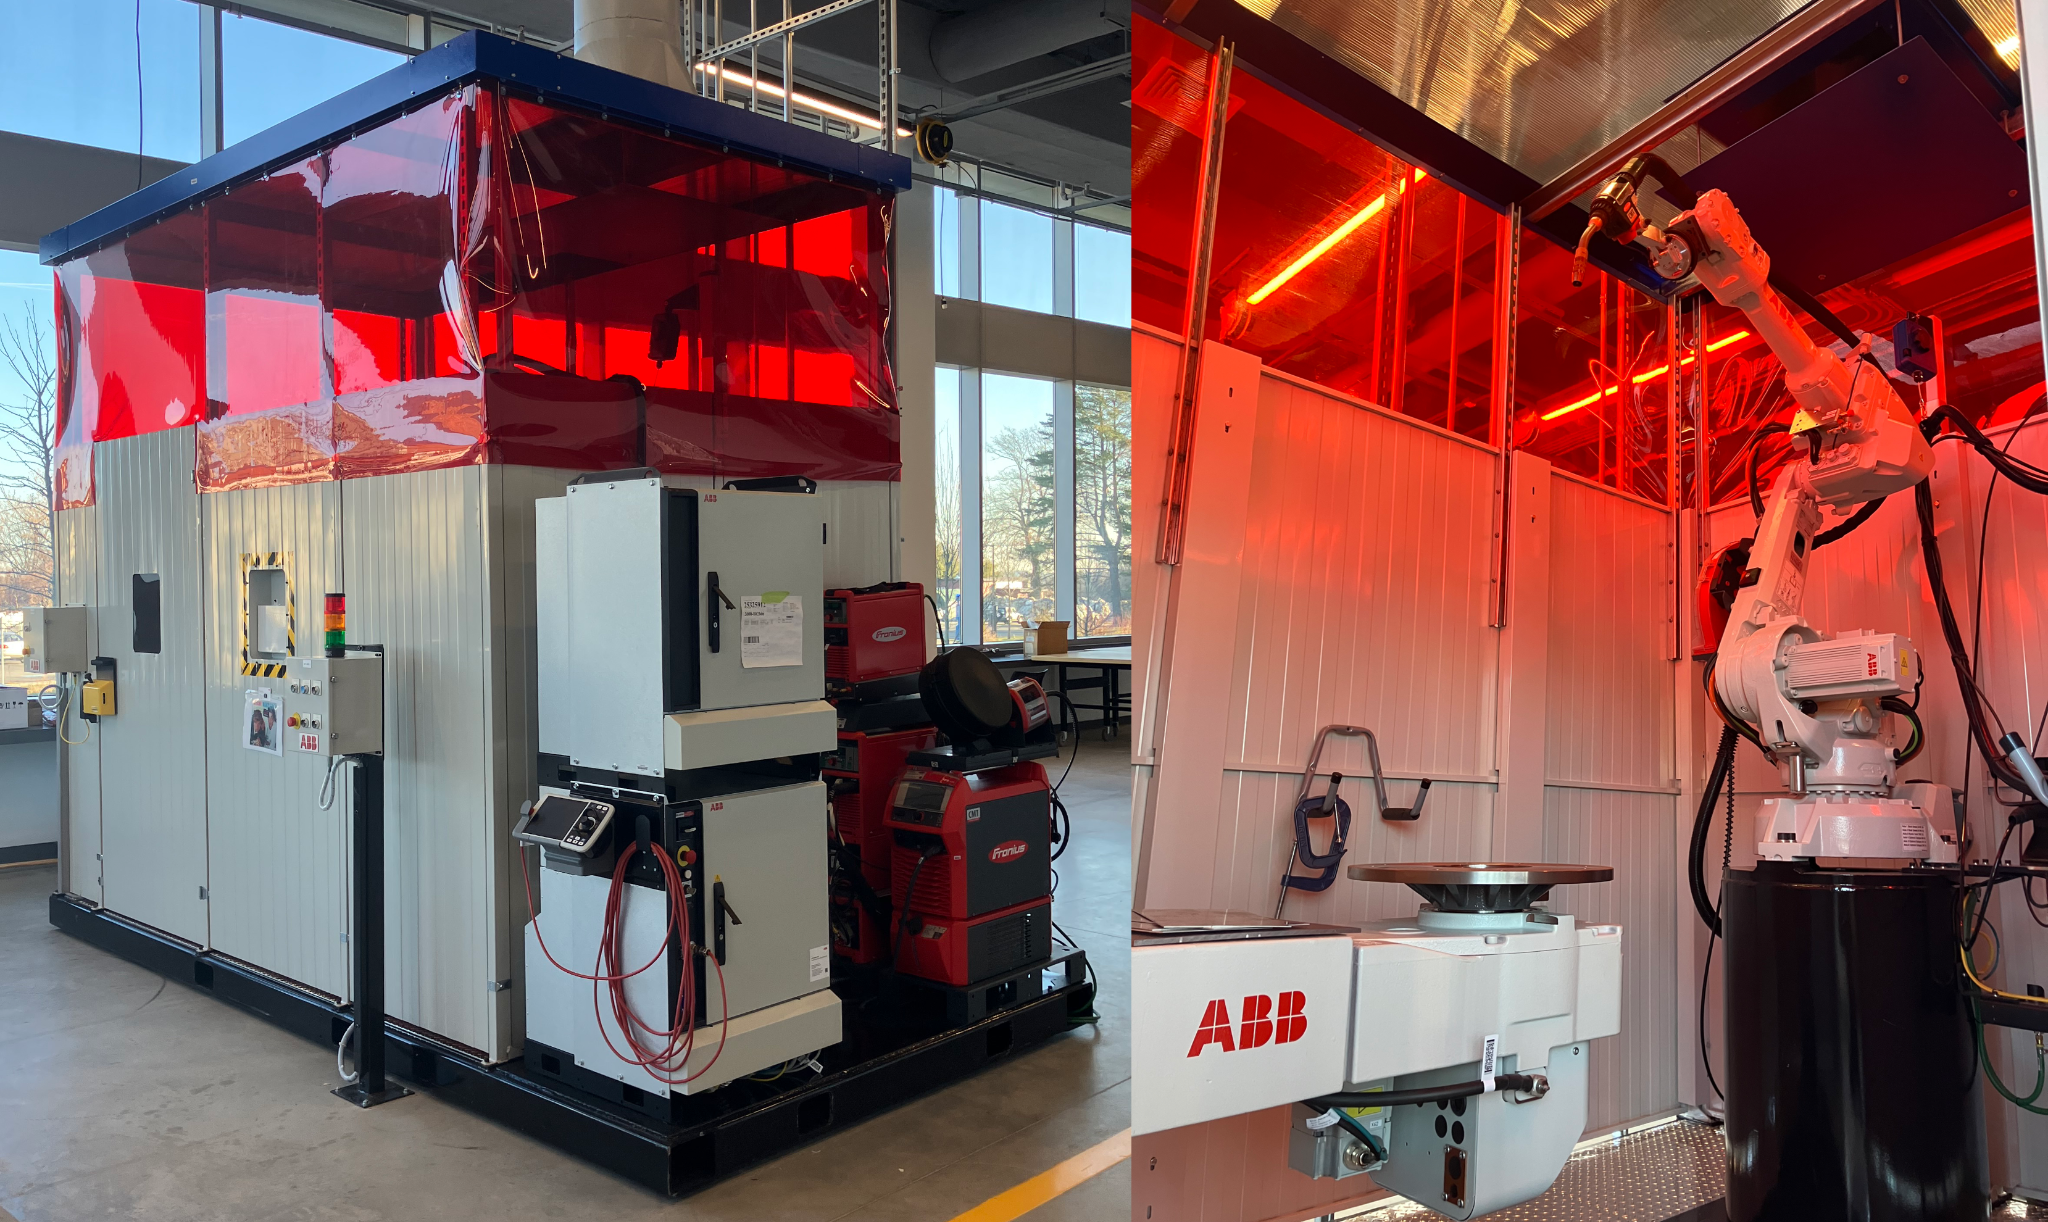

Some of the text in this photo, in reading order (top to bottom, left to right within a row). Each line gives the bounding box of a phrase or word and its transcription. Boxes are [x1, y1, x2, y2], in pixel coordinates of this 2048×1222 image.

[704, 494, 717, 502] ABB
[876, 629, 904, 639] Fronius
[1867, 653, 1877, 676] ABB
[300, 734, 318, 751] ABB
[710, 802, 723, 811] ABB
[968, 809, 979, 819] CMT
[992, 844, 1026, 860] Fronius
[1186, 990, 1308, 1058] ABB
